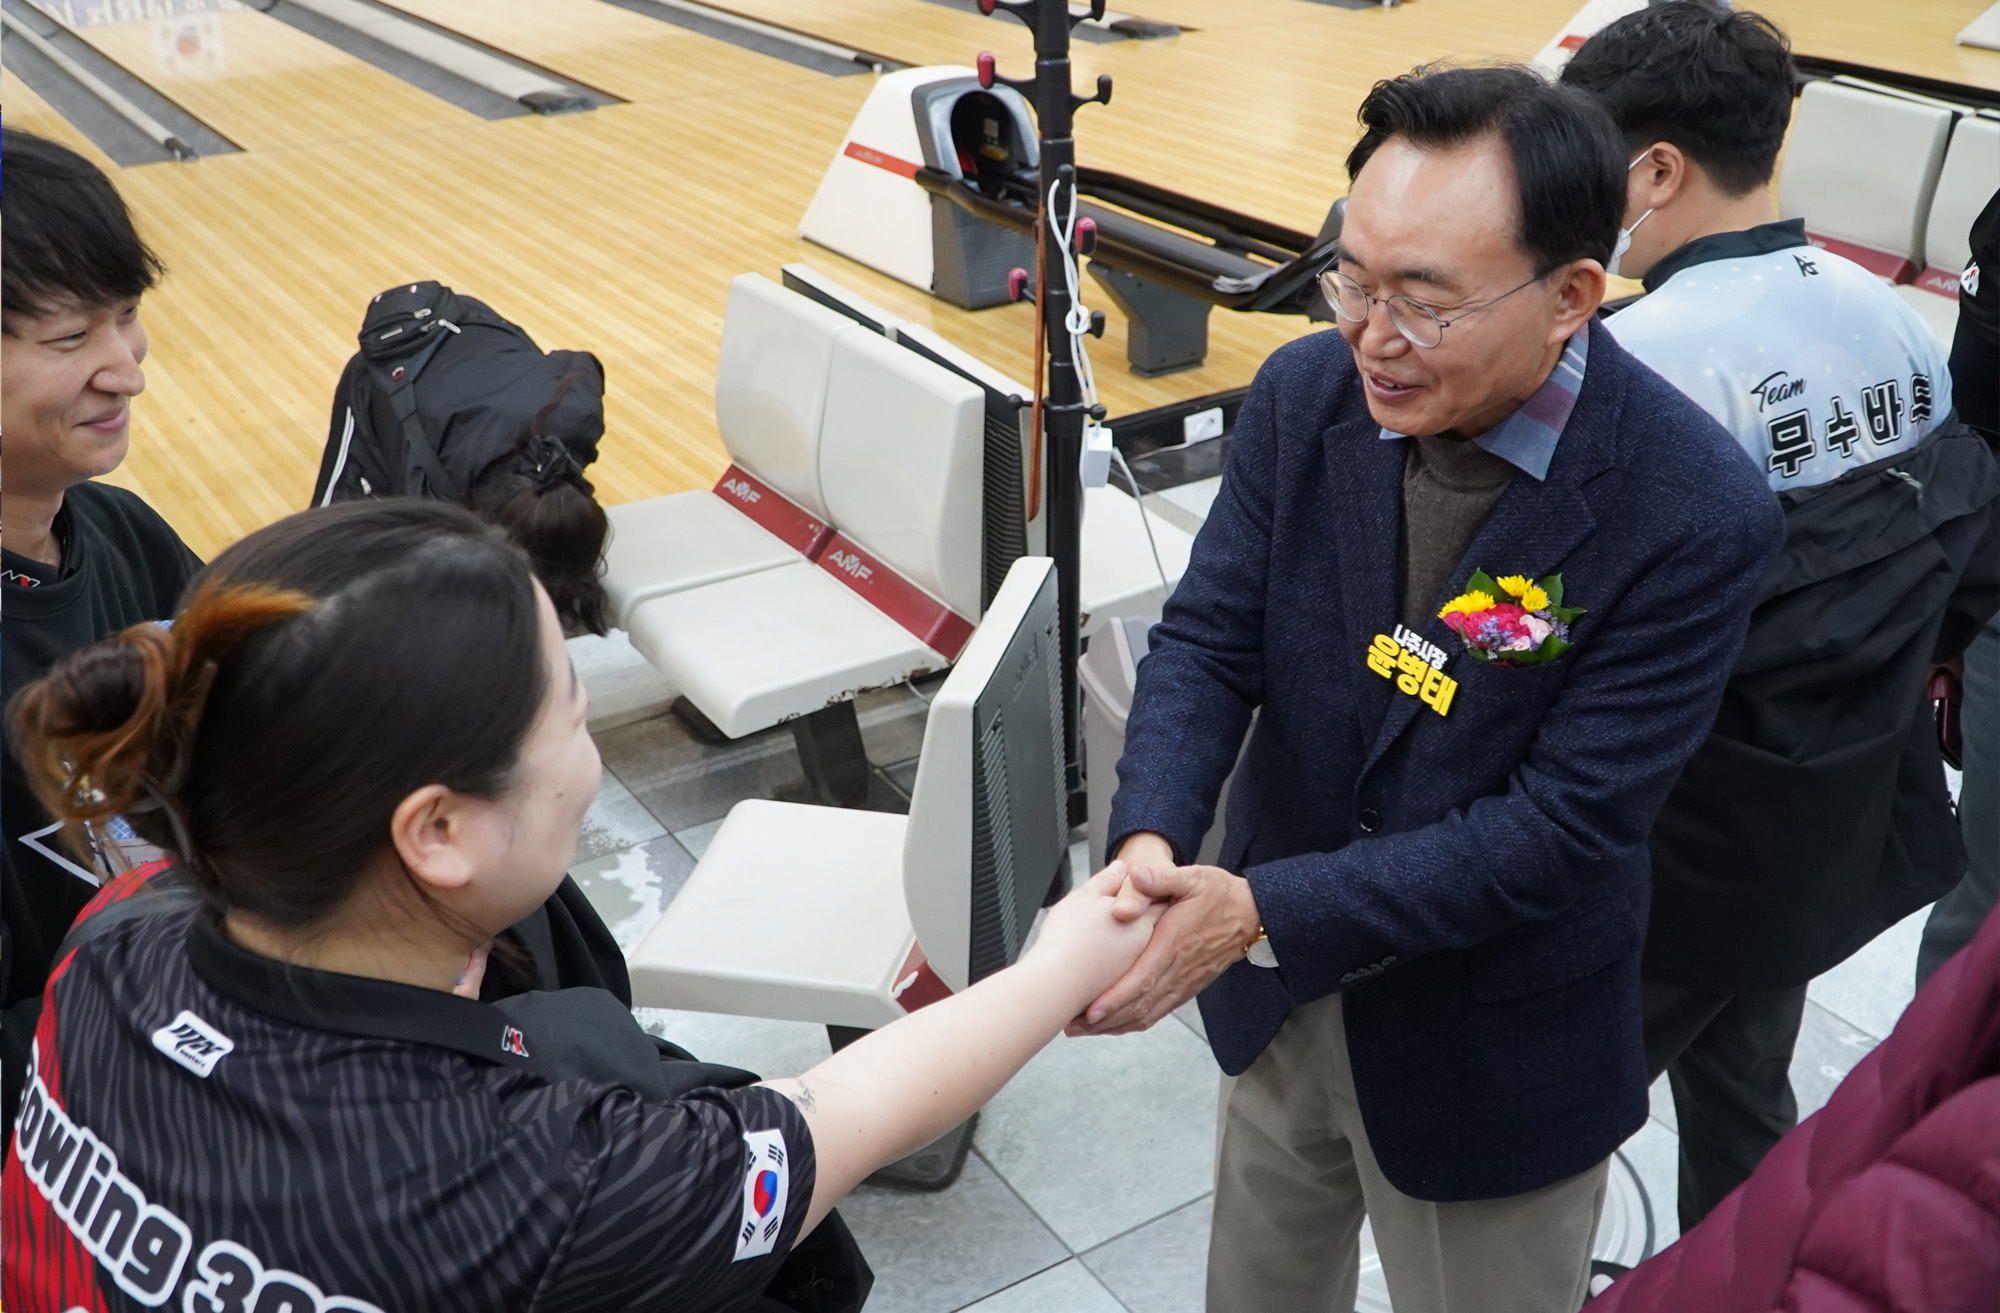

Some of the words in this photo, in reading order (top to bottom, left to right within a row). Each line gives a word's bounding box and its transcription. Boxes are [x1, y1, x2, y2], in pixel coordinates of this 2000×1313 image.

[1750, 370, 1807, 413] Team
[722, 477, 762, 504] AMF
[828, 549, 873, 580] AMF
[1393, 623, 1448, 671] 나주시장
[1367, 634, 1458, 716] 윤병태
